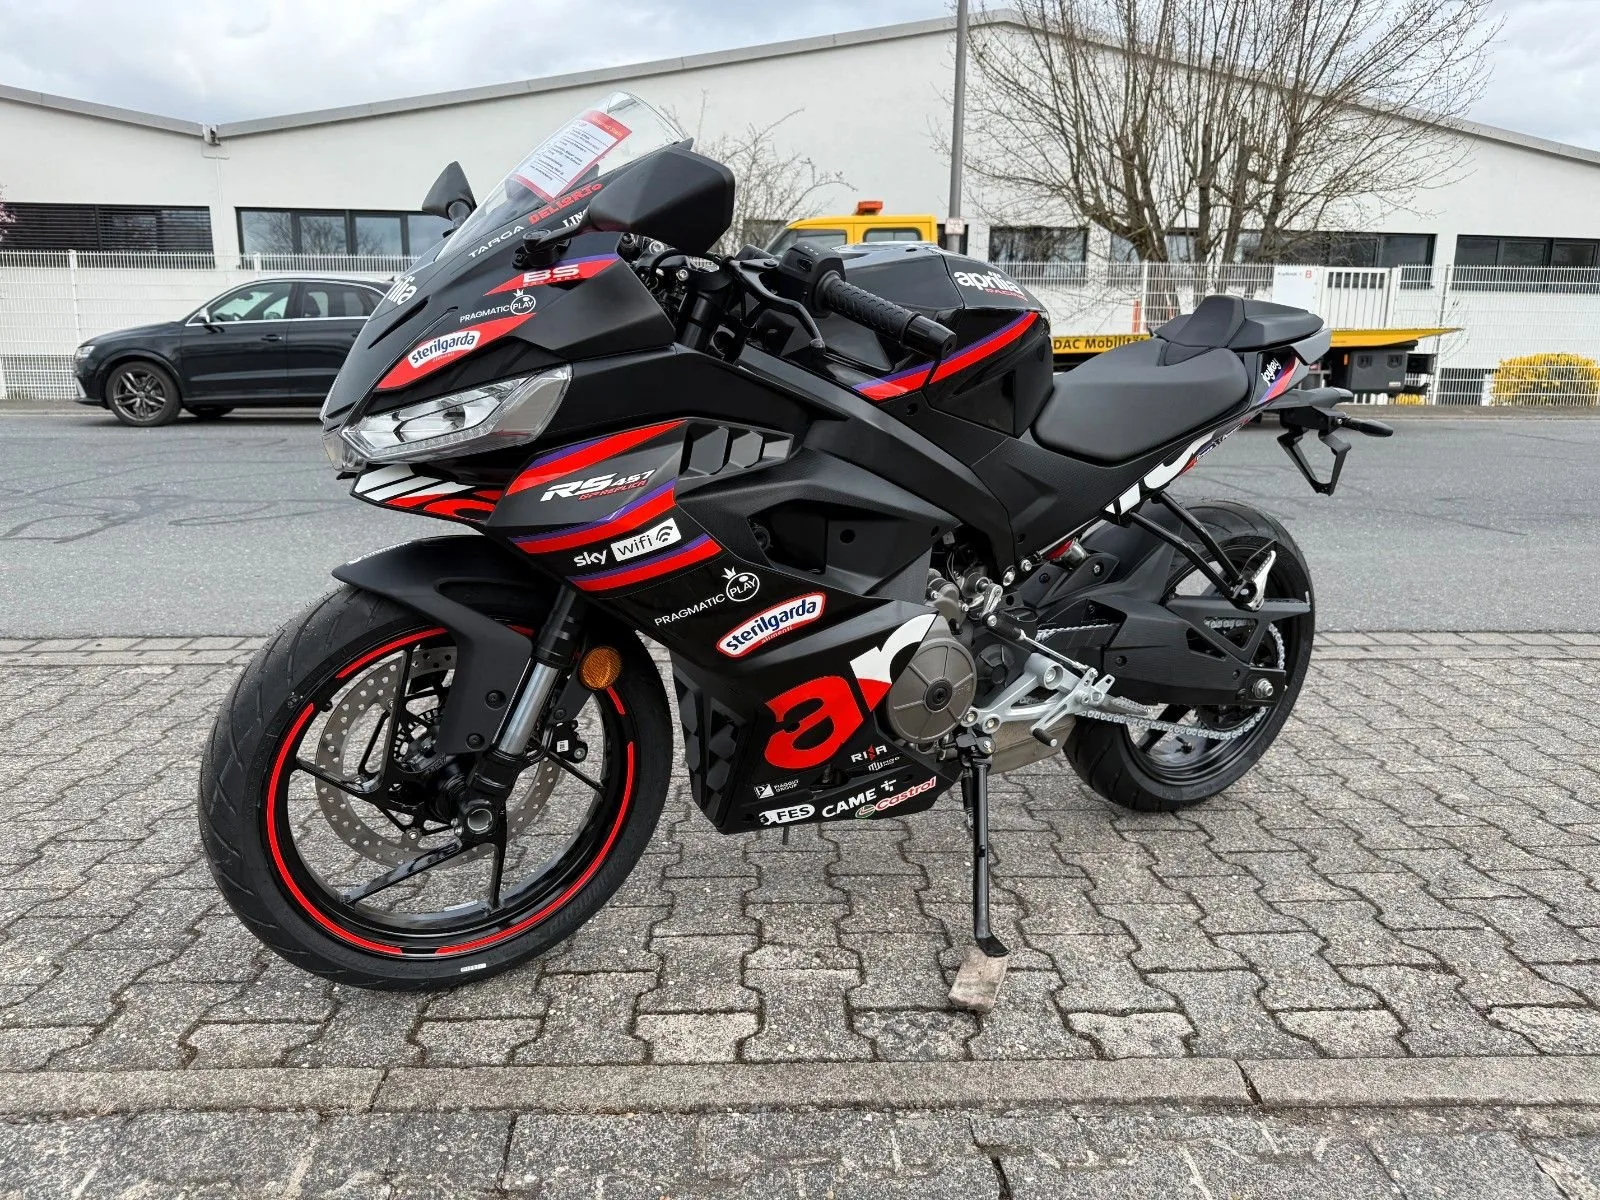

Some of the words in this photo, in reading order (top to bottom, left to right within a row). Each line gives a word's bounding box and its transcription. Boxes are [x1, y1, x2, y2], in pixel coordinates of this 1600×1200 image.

[468, 225, 524, 258] TARGA
[523, 264, 579, 283] BS
[954, 271, 1025, 297] aprilia
[459, 304, 510, 323] PRAGMATIC
[512, 300, 535, 310] PLAY
[411, 332, 476, 364] sterilgarda
[1084, 335, 1146, 349] Mobilit
[540, 472, 618, 502] RS
[611, 468, 657, 487] 457
[598, 480, 650, 498] REPLICA
[573, 549, 607, 567] sky
[617, 534, 653, 556] wifi
[654, 593, 726, 626] PRAGMATIC
[729, 578, 756, 597] PLAY
[726, 599, 817, 651] sterilgarda
[761, 626, 793, 643] alimenti
[822, 788, 877, 818] CAME
[875, 776, 937, 811] Castrol
[776, 805, 810, 820] FES
